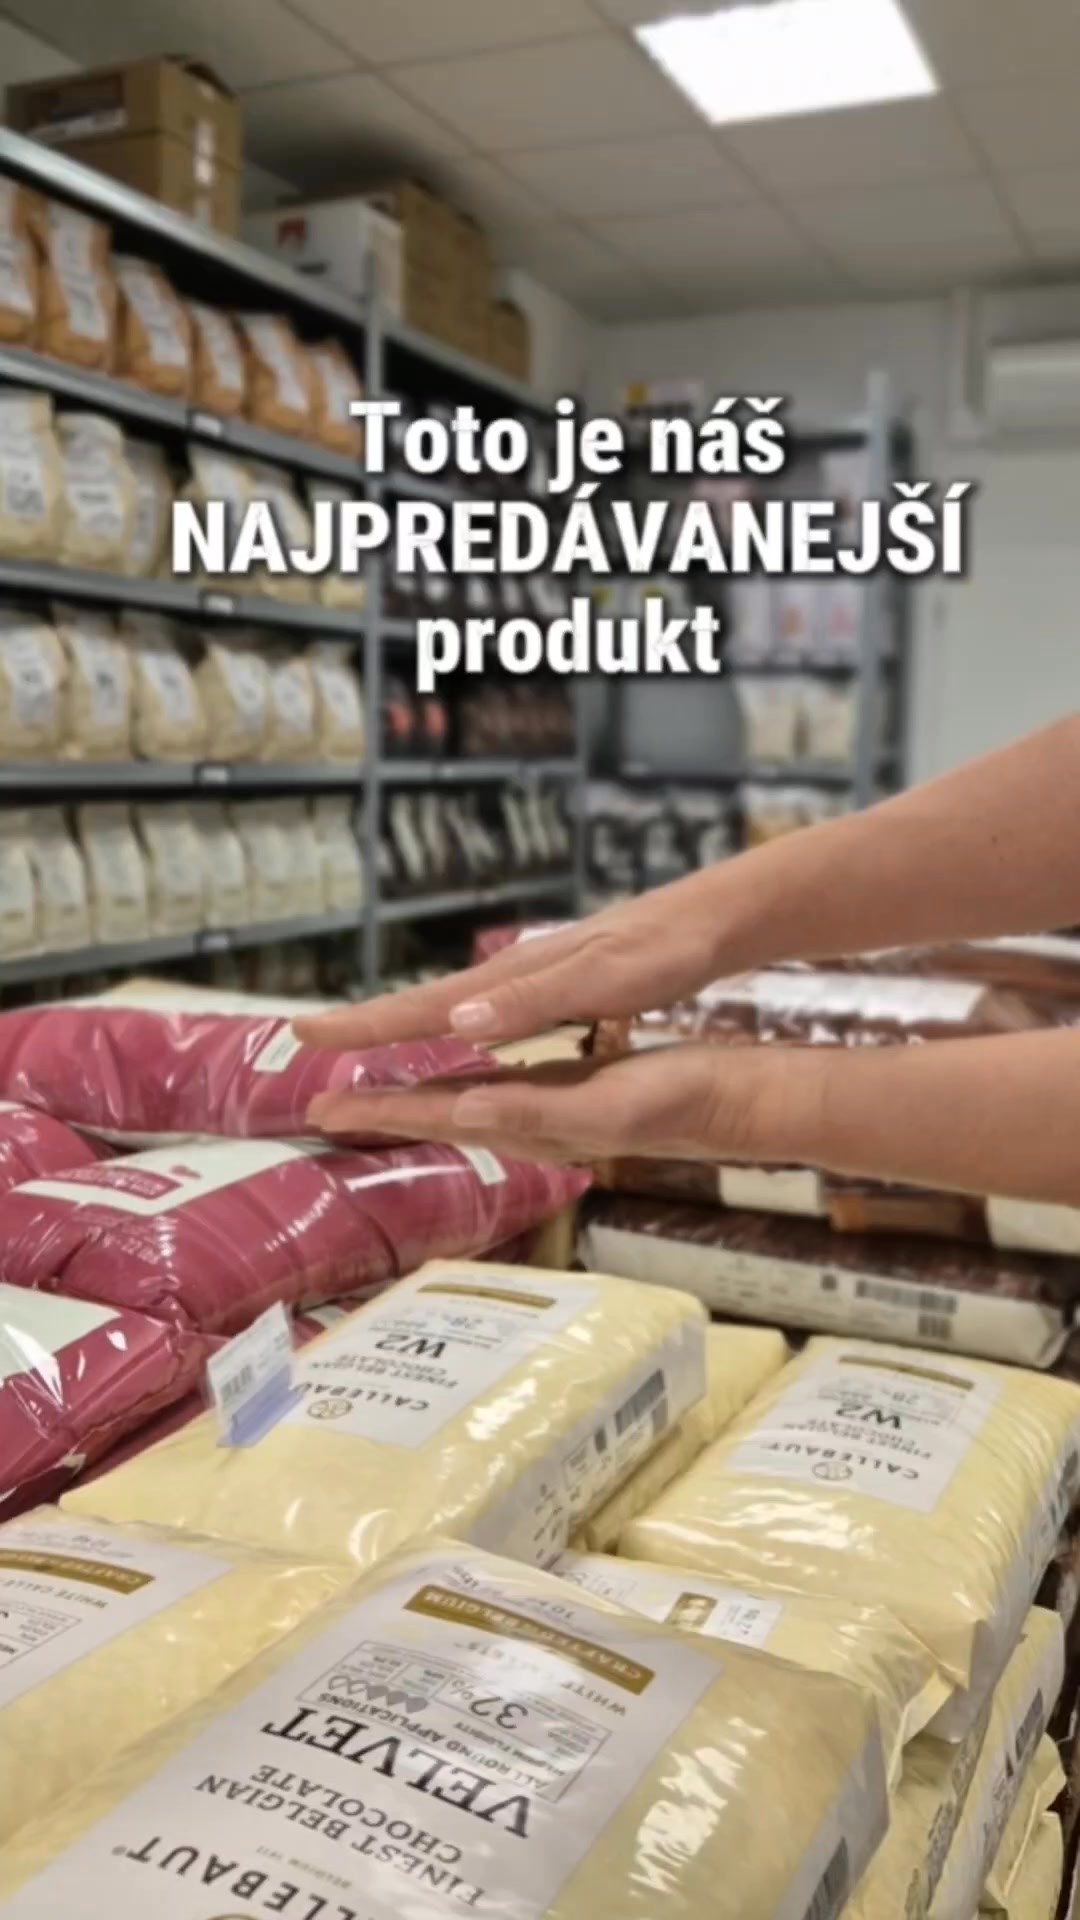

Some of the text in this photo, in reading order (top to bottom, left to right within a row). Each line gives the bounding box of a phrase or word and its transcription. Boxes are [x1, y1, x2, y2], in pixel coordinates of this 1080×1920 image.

[375, 1334, 446, 1358] W2
[294, 1382, 428, 1411] CALLEBAU
[836, 1404, 902, 1429] W2
[317, 1693, 446, 1743] APPLICATIONS
[450, 1678, 529, 1730] 32%
[260, 1706, 531, 1840] VELVET
[194, 1773, 485, 1907] FINEST BELGIAN
[249, 1764, 463, 1865] CHOCOLATE
